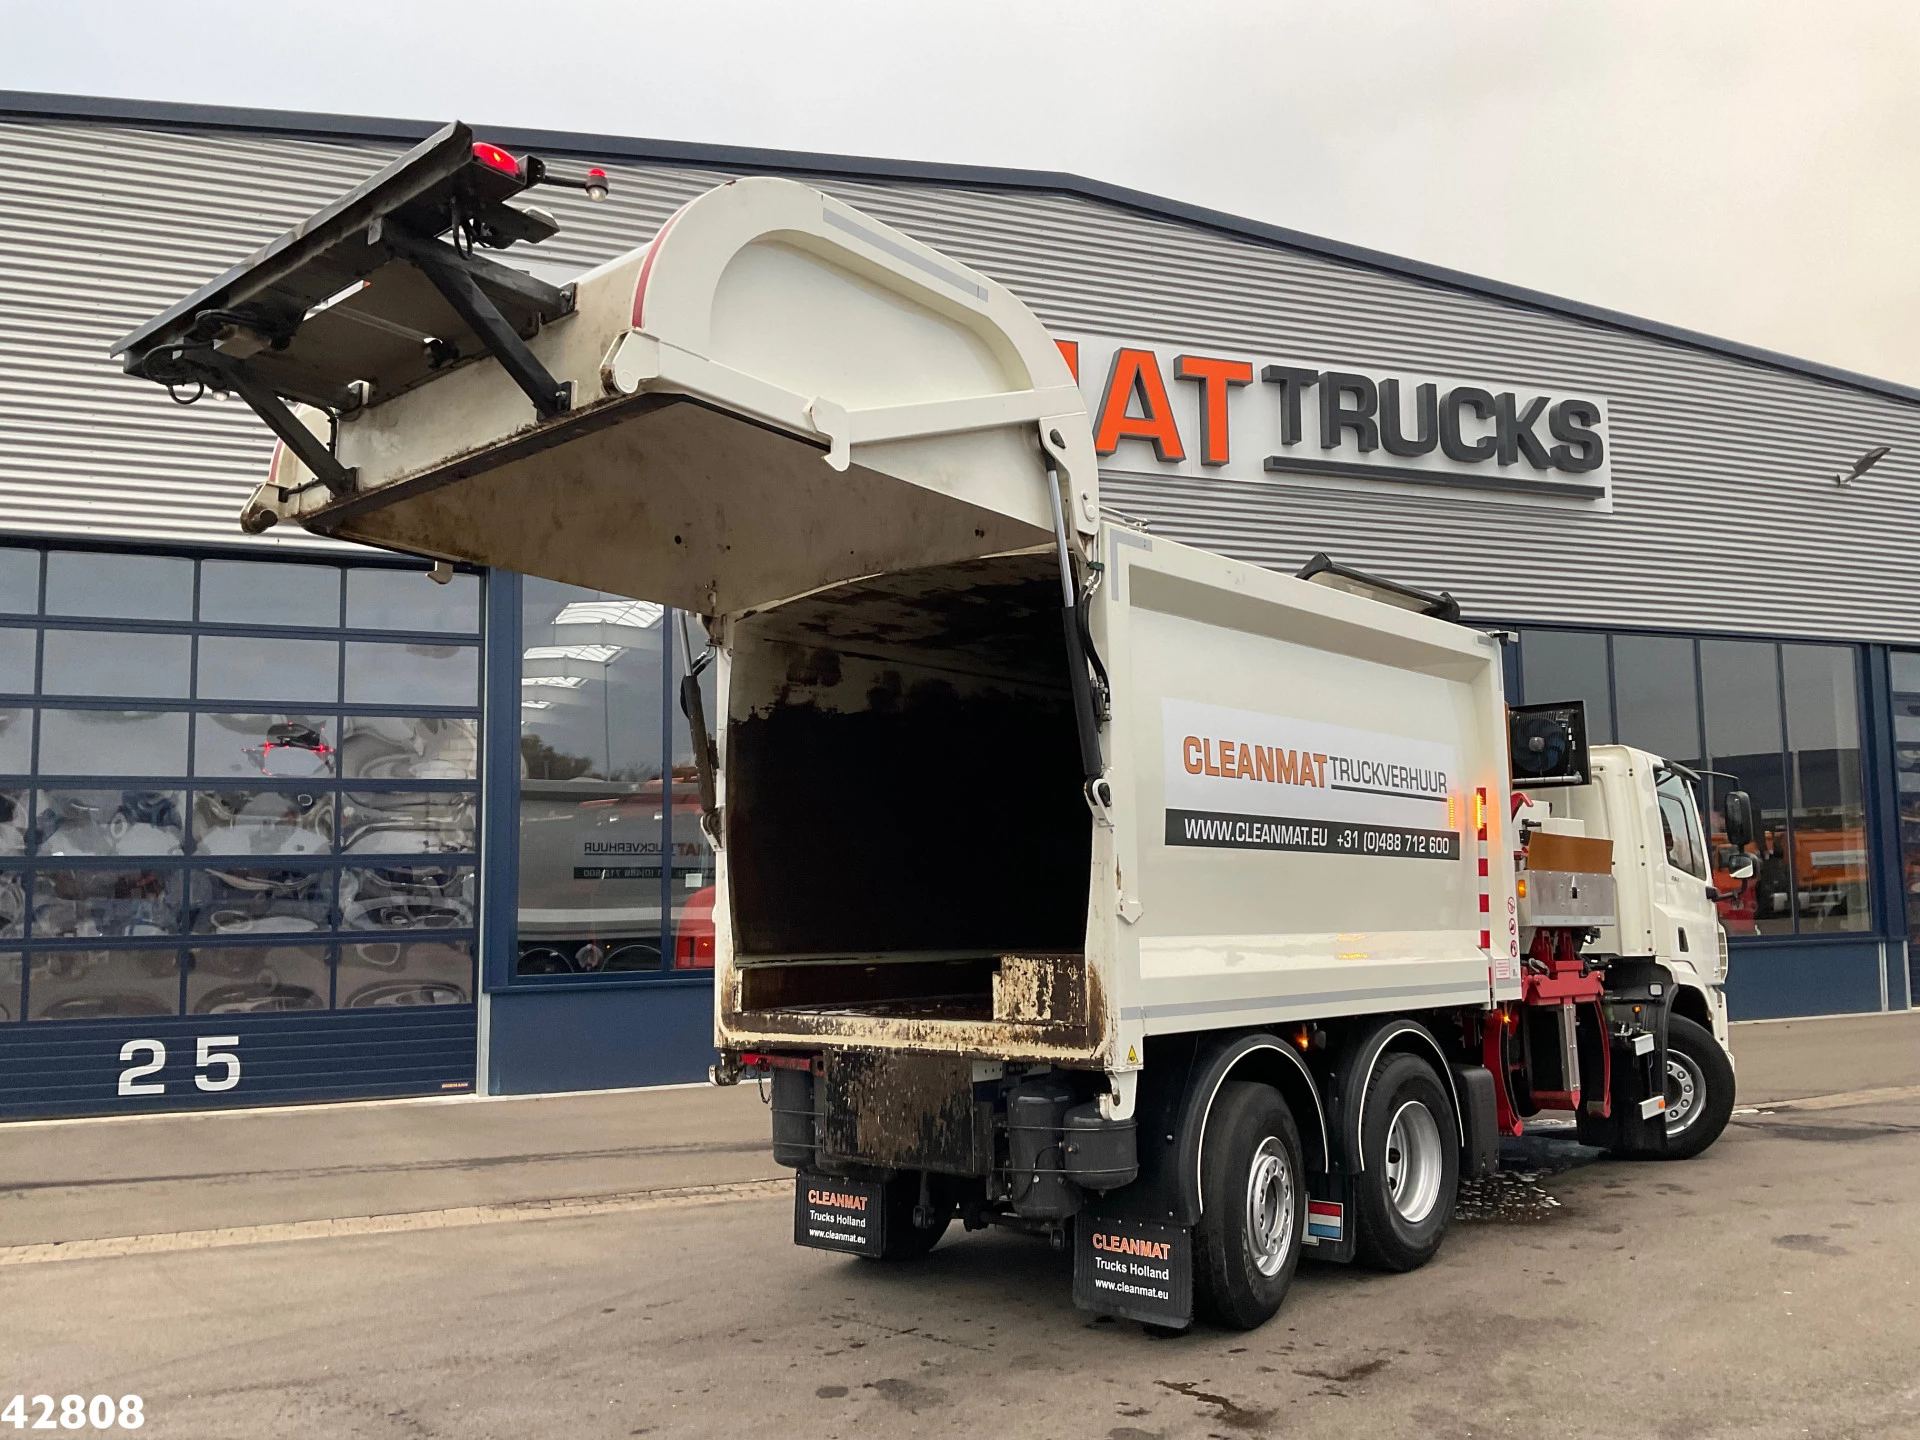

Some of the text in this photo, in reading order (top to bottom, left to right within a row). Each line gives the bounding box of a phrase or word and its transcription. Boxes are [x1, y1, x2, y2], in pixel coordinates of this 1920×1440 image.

[1261, 364, 1603, 473] TRUCKS
[1183, 735, 1447, 793] CLEANMAT TRUCKVERHUUR
[1185, 818, 1449, 854] WWW.CLEANMAT.EU +31 (0)488 712 600
[808, 1189, 868, 1211] CLEANMAT
[809, 1209, 866, 1228] Trucks Holland
[809, 1228, 866, 1244] www.cleanmat.eu
[1092, 1233, 1171, 1260] CLEANMAT
[1095, 1256, 1170, 1280] Trucks Holland
[1095, 1278, 1169, 1300] www.cleanmat.eu
